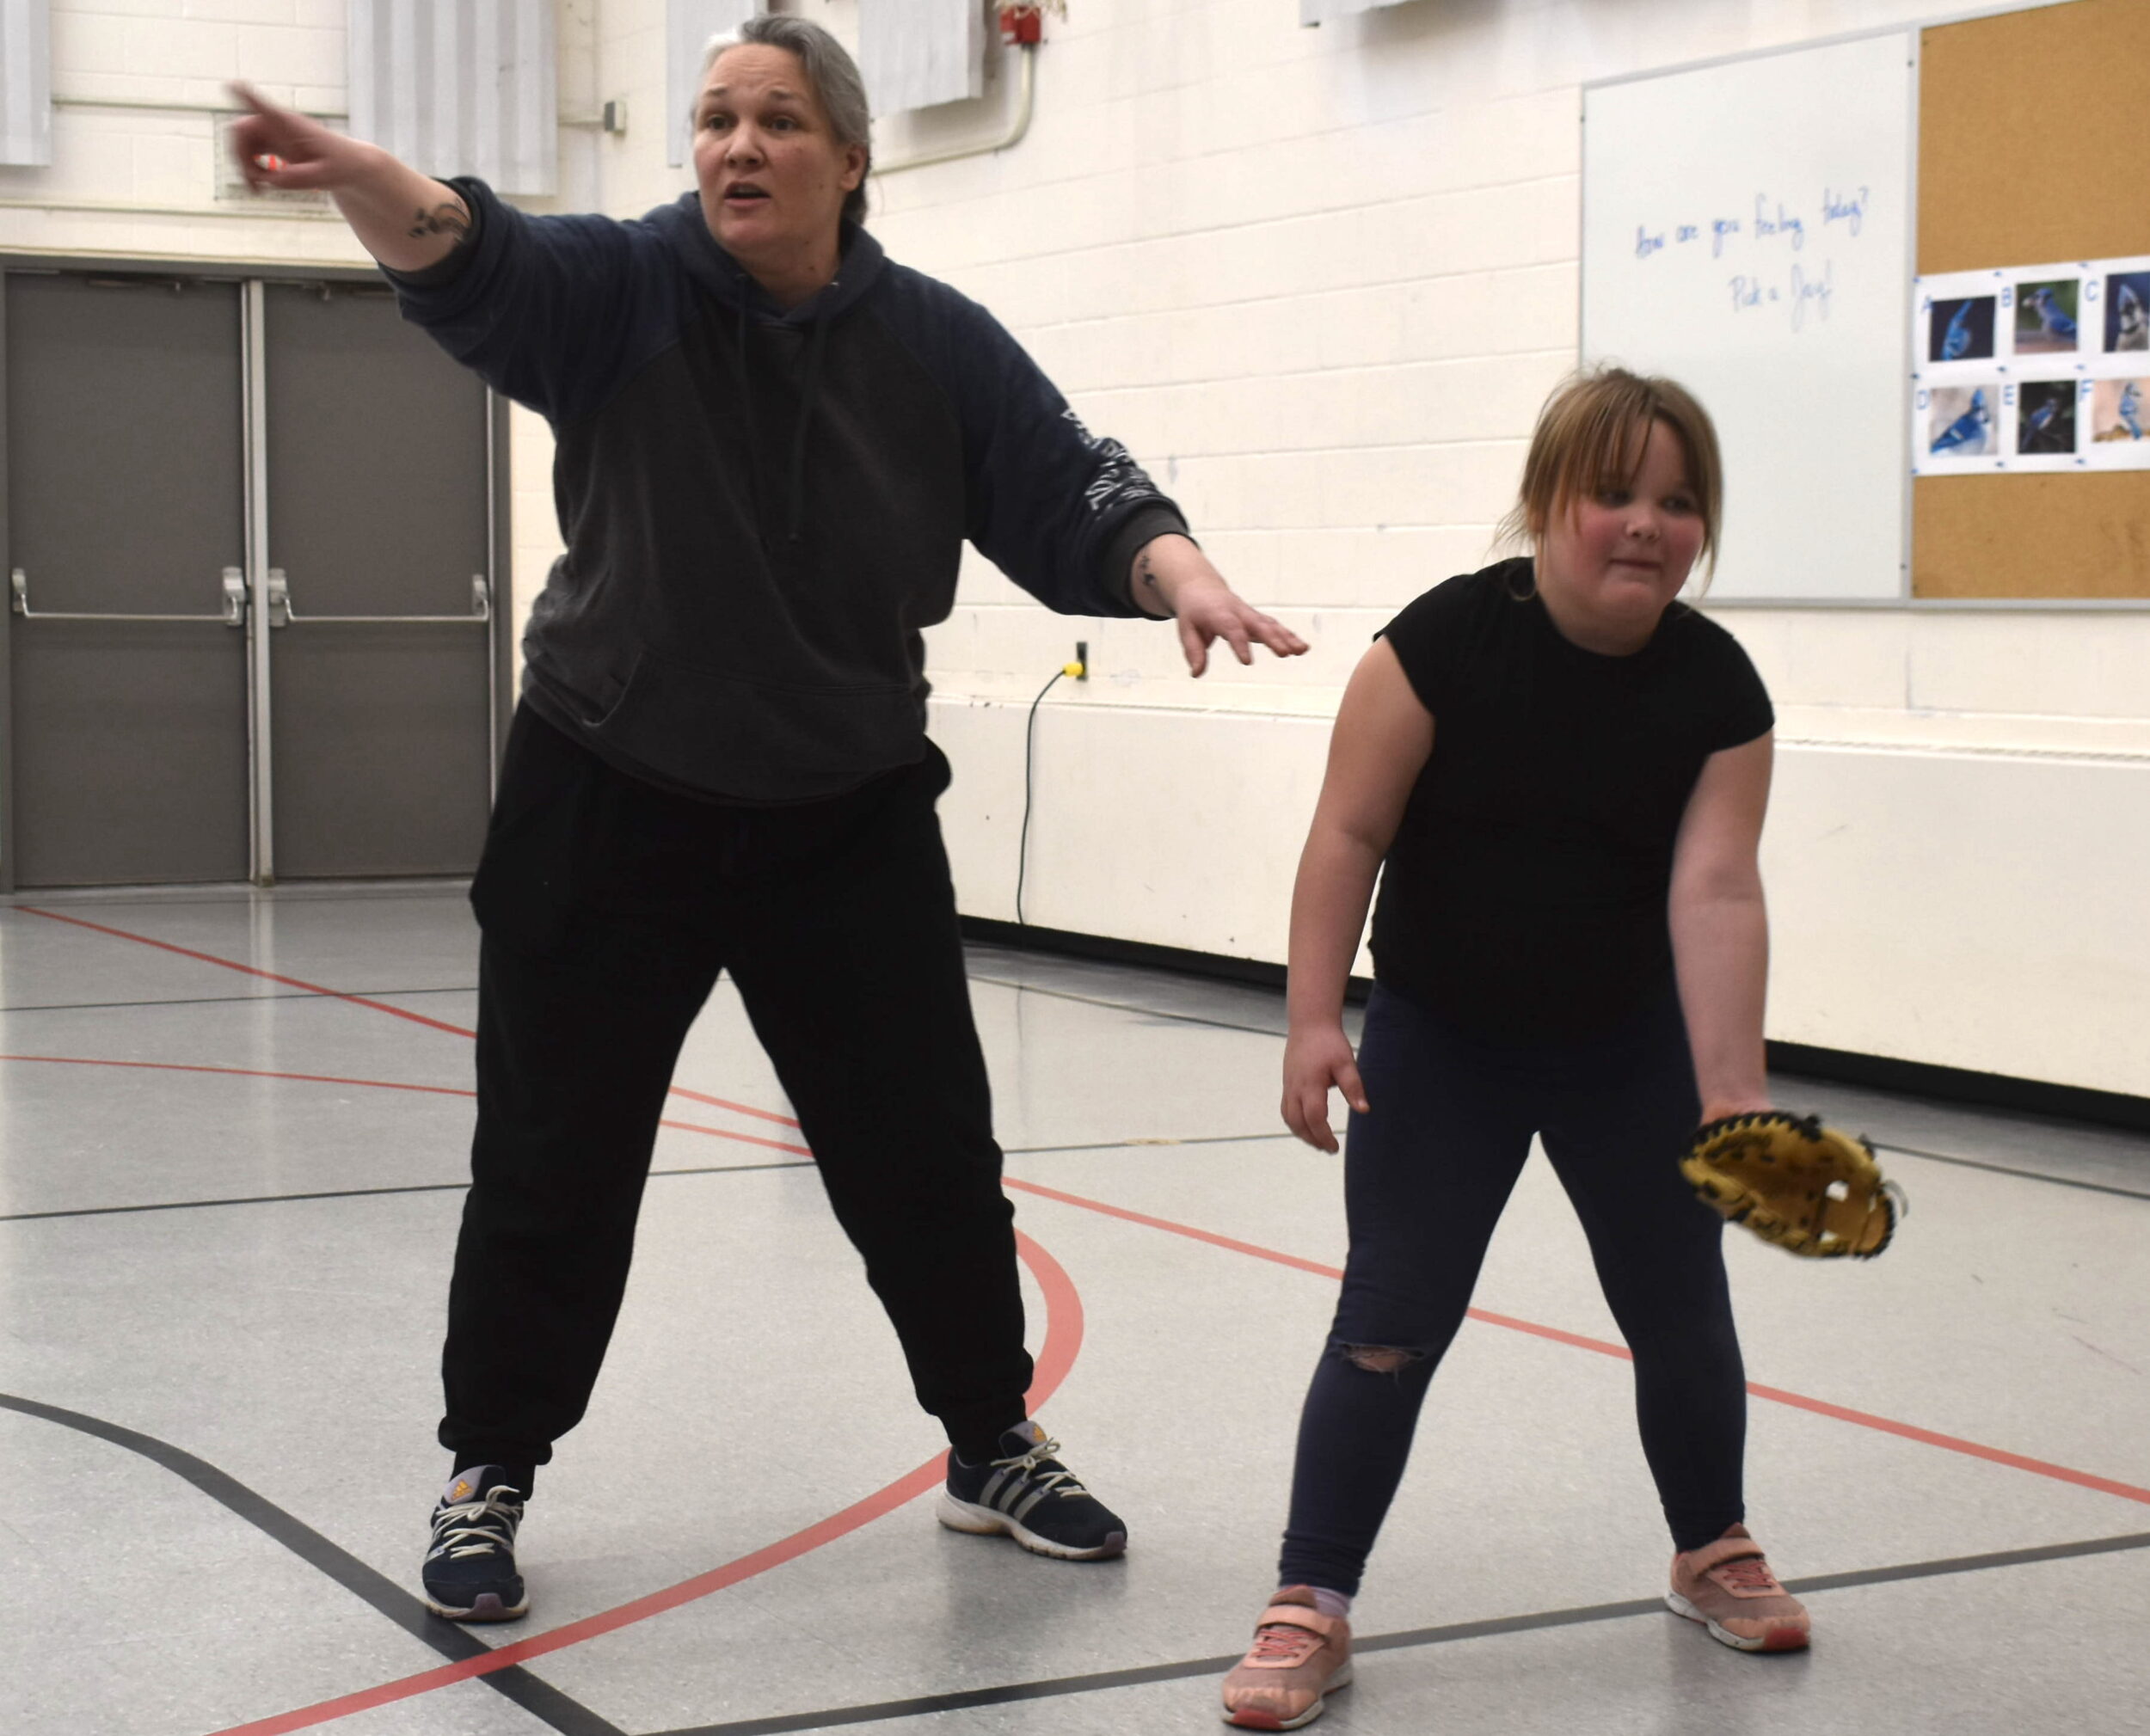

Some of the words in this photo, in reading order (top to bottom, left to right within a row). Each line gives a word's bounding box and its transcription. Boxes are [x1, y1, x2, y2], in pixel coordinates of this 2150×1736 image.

[2001, 286, 2013, 308] B
[2085, 280, 2099, 302] C
[2004, 384, 2014, 406] E
[2079, 379, 2093, 402] F
